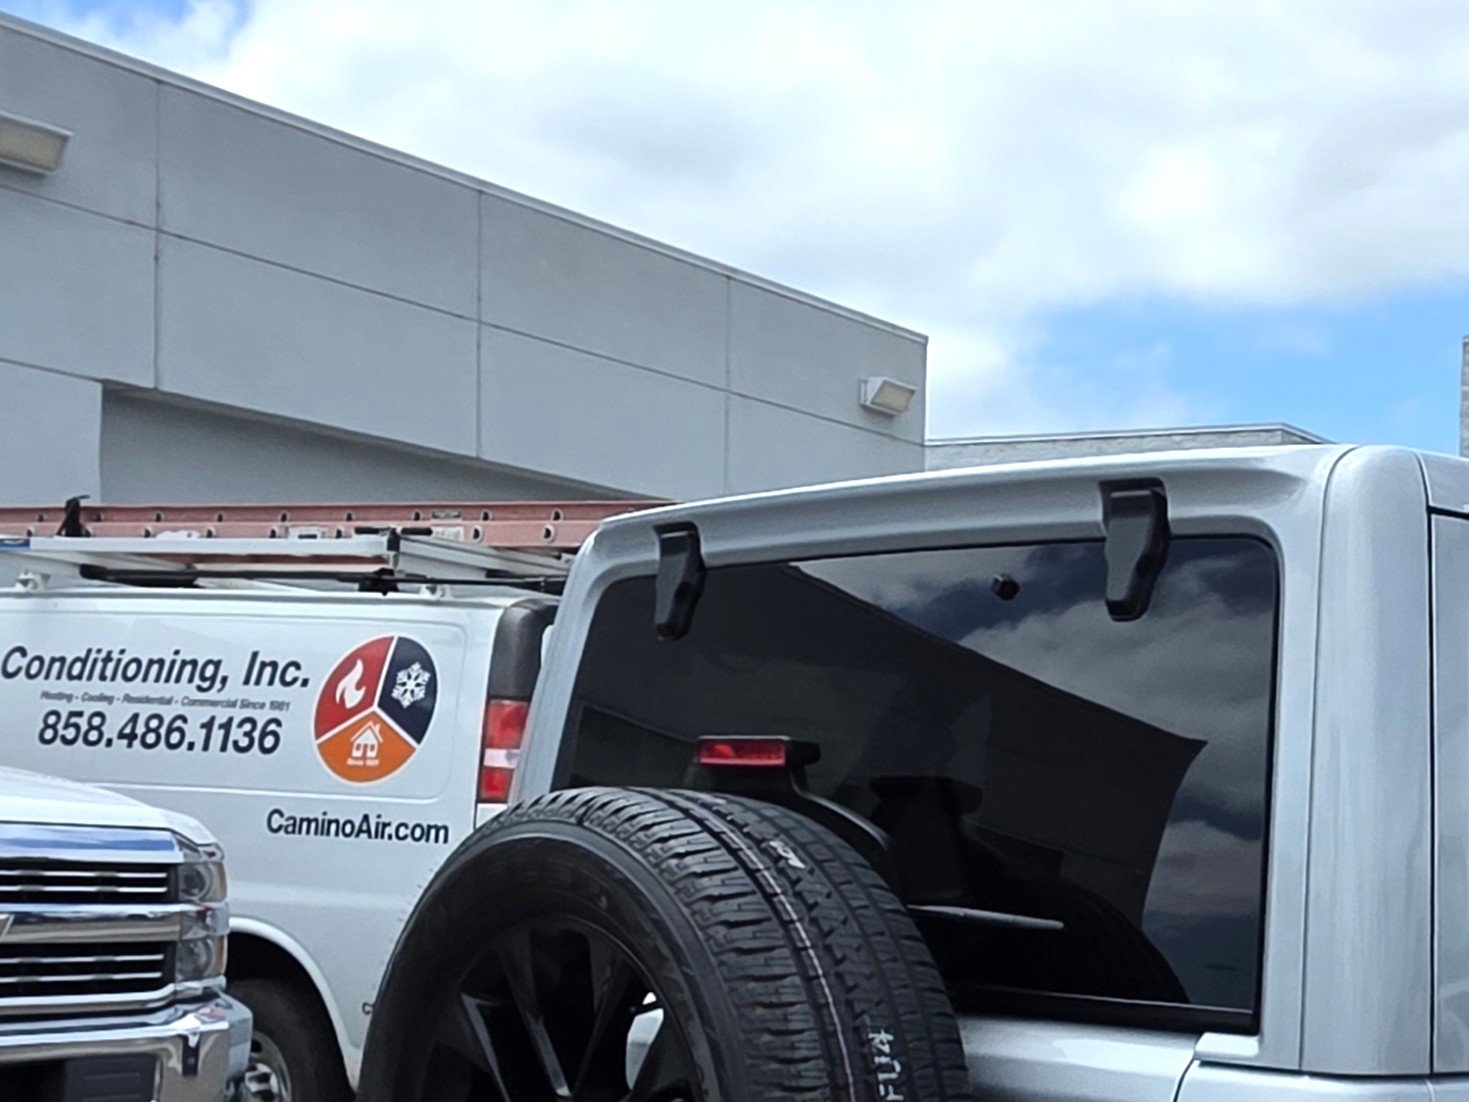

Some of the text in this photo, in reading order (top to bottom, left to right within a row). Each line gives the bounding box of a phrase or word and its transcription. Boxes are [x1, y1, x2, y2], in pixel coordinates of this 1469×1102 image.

[1, 645, 310, 693] Conditioning, Inc.
[121, 693, 174, 706] Residential
[181, 696, 238, 708] Commercial
[239, 698, 266, 710] Since
[38, 709, 283, 755] 858.486.1136
[266, 808, 450, 844] CaminoAir.com
